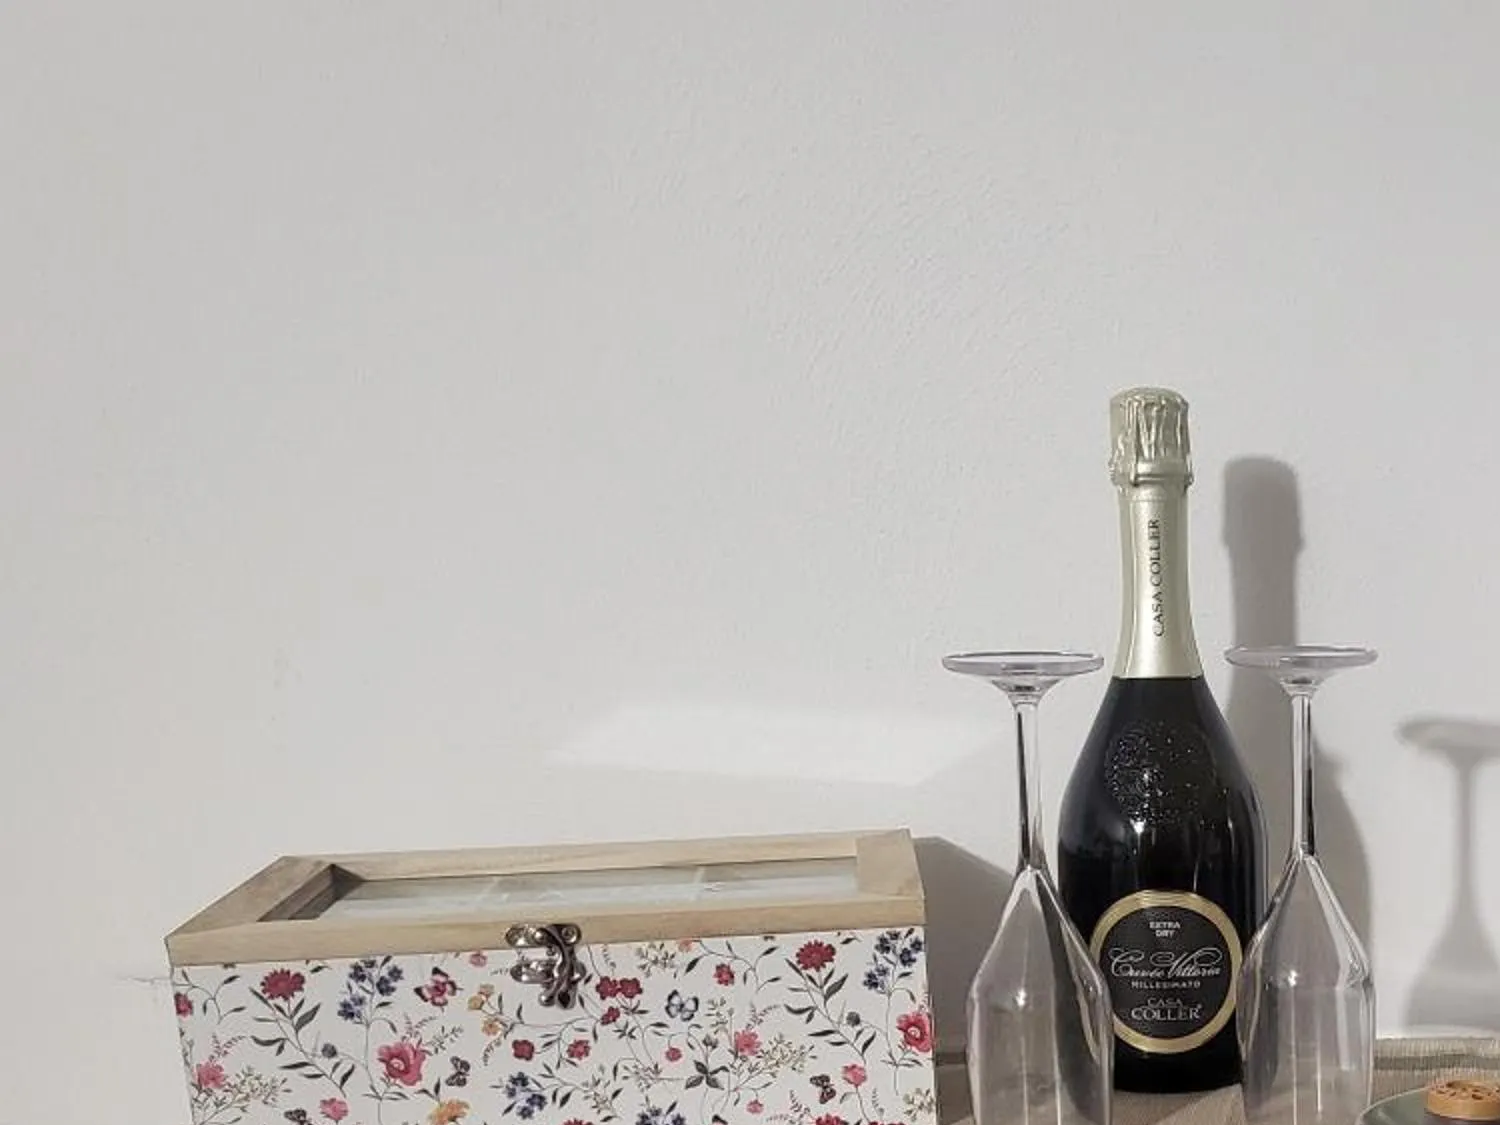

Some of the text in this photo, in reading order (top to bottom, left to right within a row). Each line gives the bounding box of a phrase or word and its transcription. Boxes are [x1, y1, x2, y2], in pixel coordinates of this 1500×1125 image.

[1147, 518, 1165, 637] CASA COLLER
[1149, 921, 1181, 929] EXTRA
[1155, 929, 1175, 937] DRY
[1147, 997, 1183, 1008] CASA
